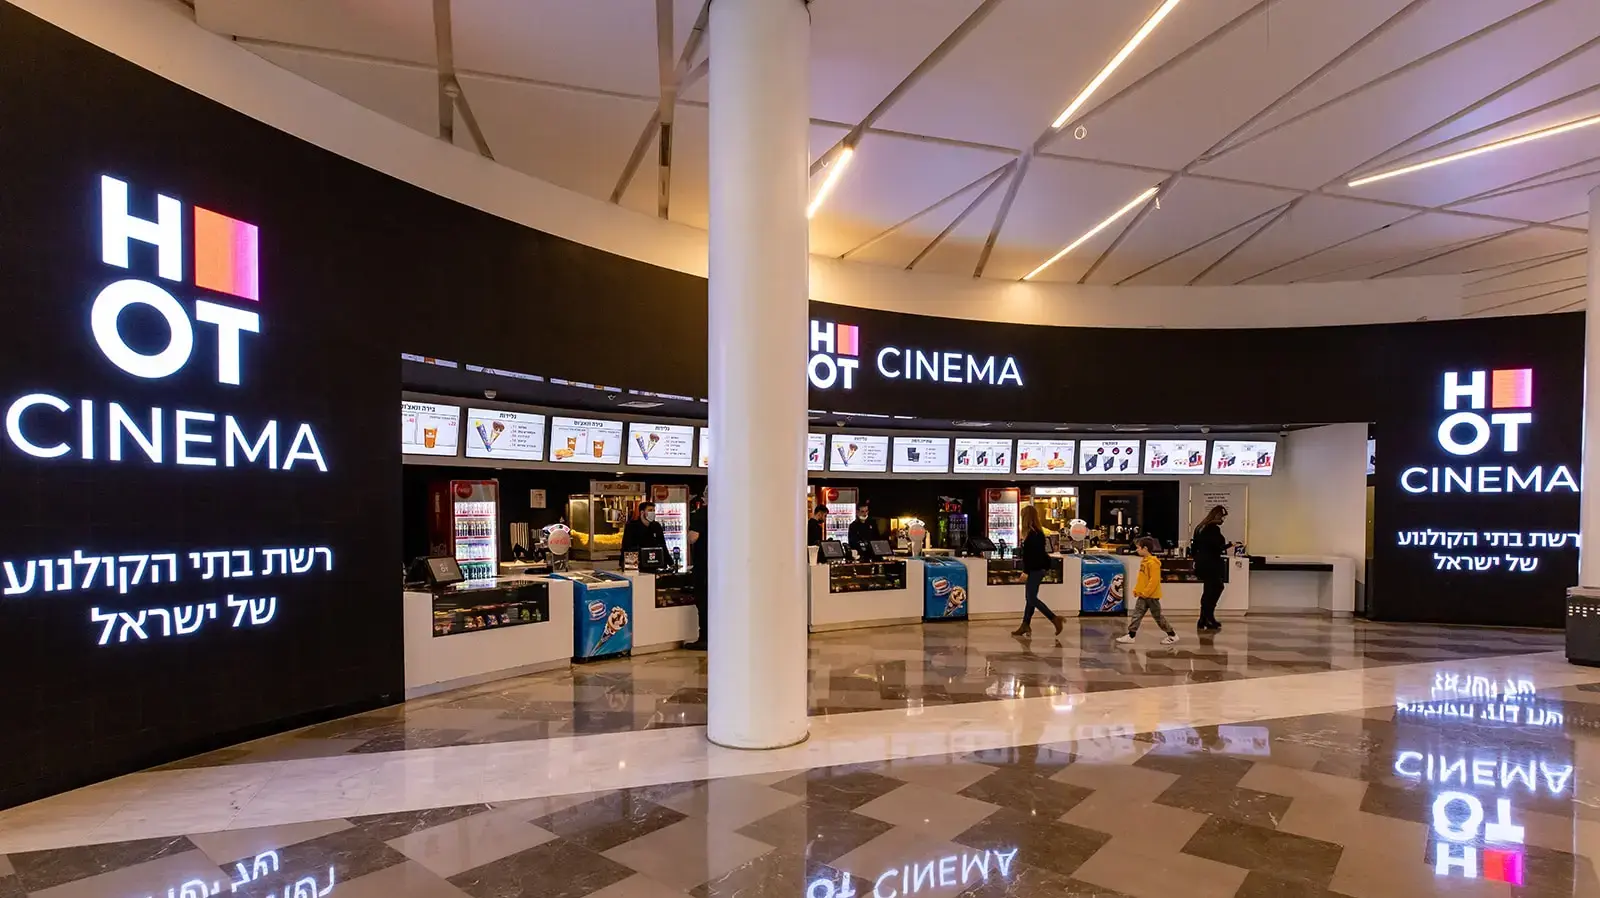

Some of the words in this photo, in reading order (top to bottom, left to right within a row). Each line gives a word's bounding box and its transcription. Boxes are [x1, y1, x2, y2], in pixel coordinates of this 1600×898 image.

[876, 346, 1024, 387] CINEMA
[5, 393, 329, 472] CINEMA
[1401, 465, 1580, 493] CINEMA
[1398, 528, 1478, 549] הקולנוע
[1484, 532, 1524, 547] בתי
[1529, 531, 1581, 548] רשת
[3, 549, 177, 595] הקולנוע
[189, 550, 253, 580] בתי
[262, 546, 333, 576] רשת
[1433, 552, 1500, 571] ישראל
[1506, 553, 1539, 572] של
[91, 602, 217, 645] ישראל
[227, 594, 277, 628] של
